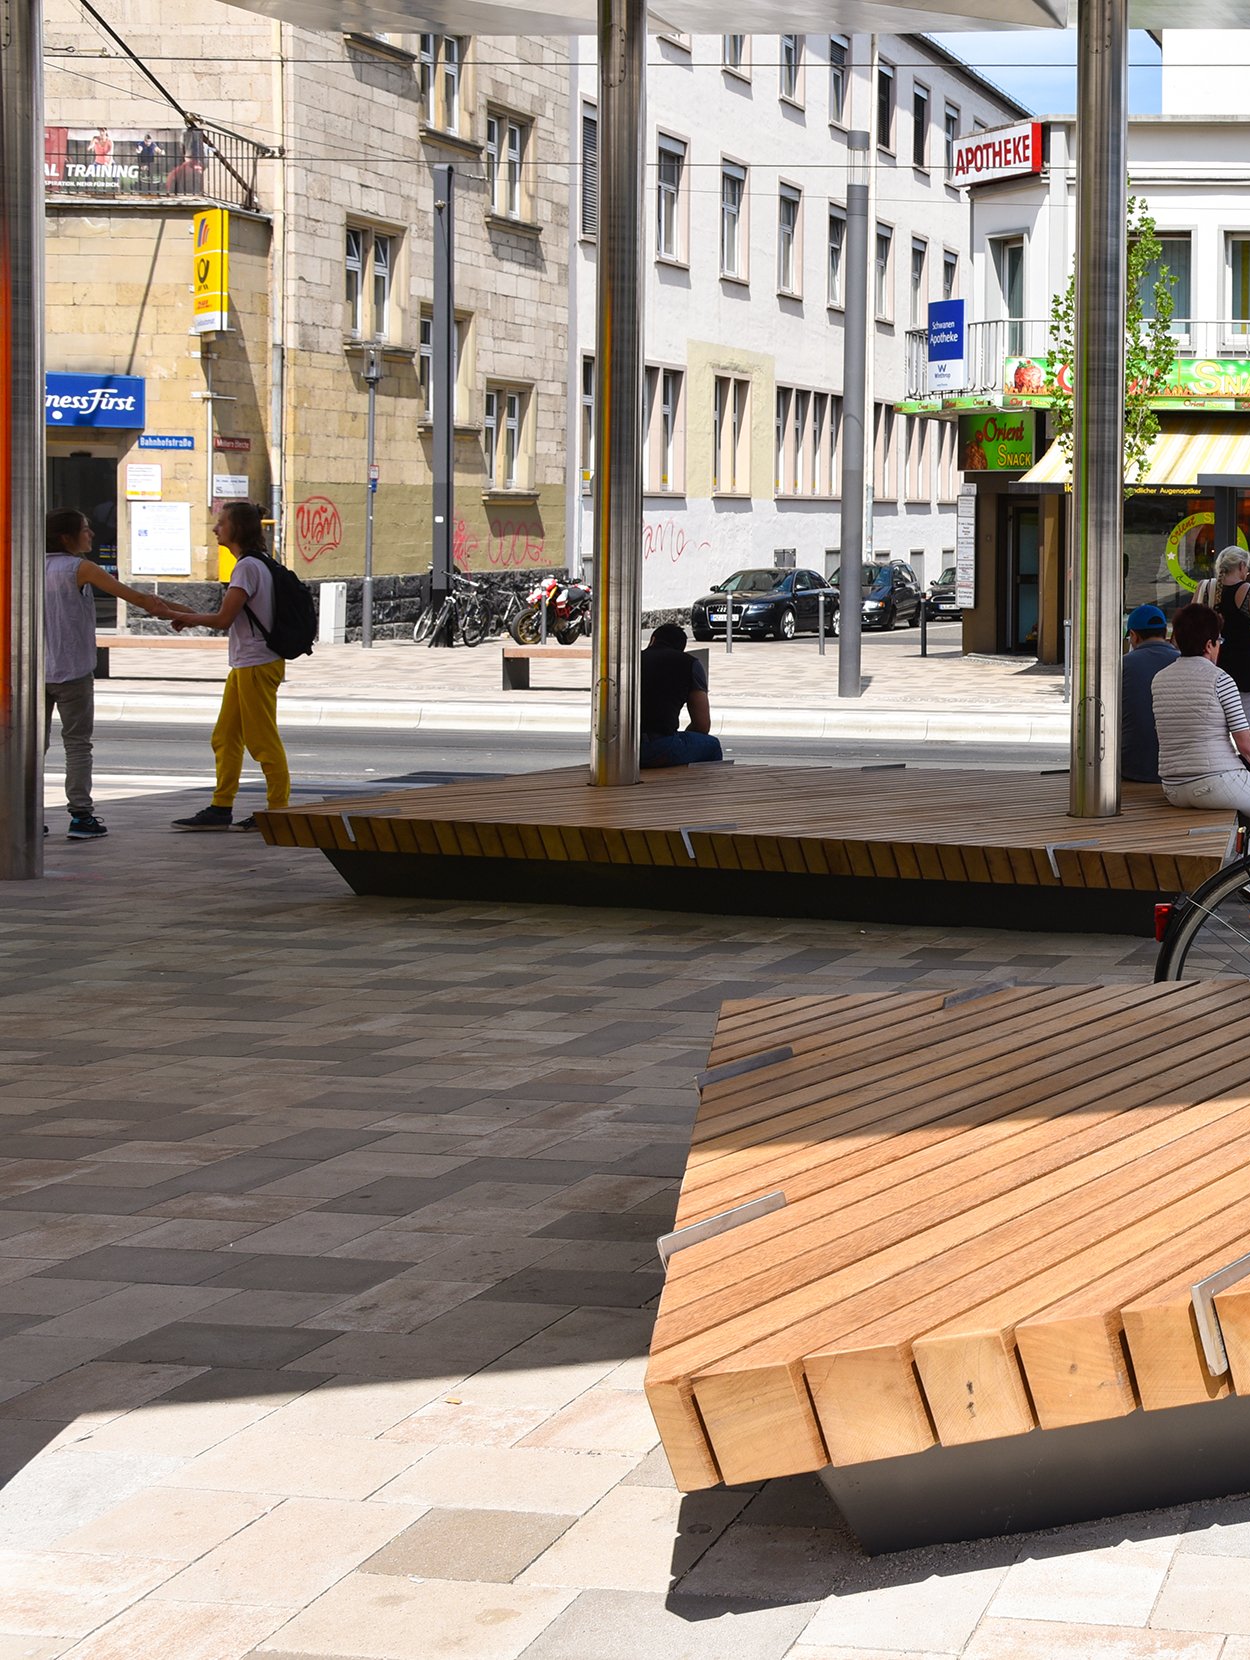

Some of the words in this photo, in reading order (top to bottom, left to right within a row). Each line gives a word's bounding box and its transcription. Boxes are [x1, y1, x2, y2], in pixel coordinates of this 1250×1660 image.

[955, 134, 1030, 177] APOTHEKE
[65, 163, 139, 179] TRAINING
[932, 321, 956, 330] Schwanen
[930, 331, 959, 347] Apotheke
[982, 416, 1025, 443] Orient
[140, 437, 193, 448] Bahnhofstraße
[997, 444, 1032, 467] SNACK
[1160, 487, 1202, 495] Augenoptiker
[1170, 515, 1196, 545] Orient
